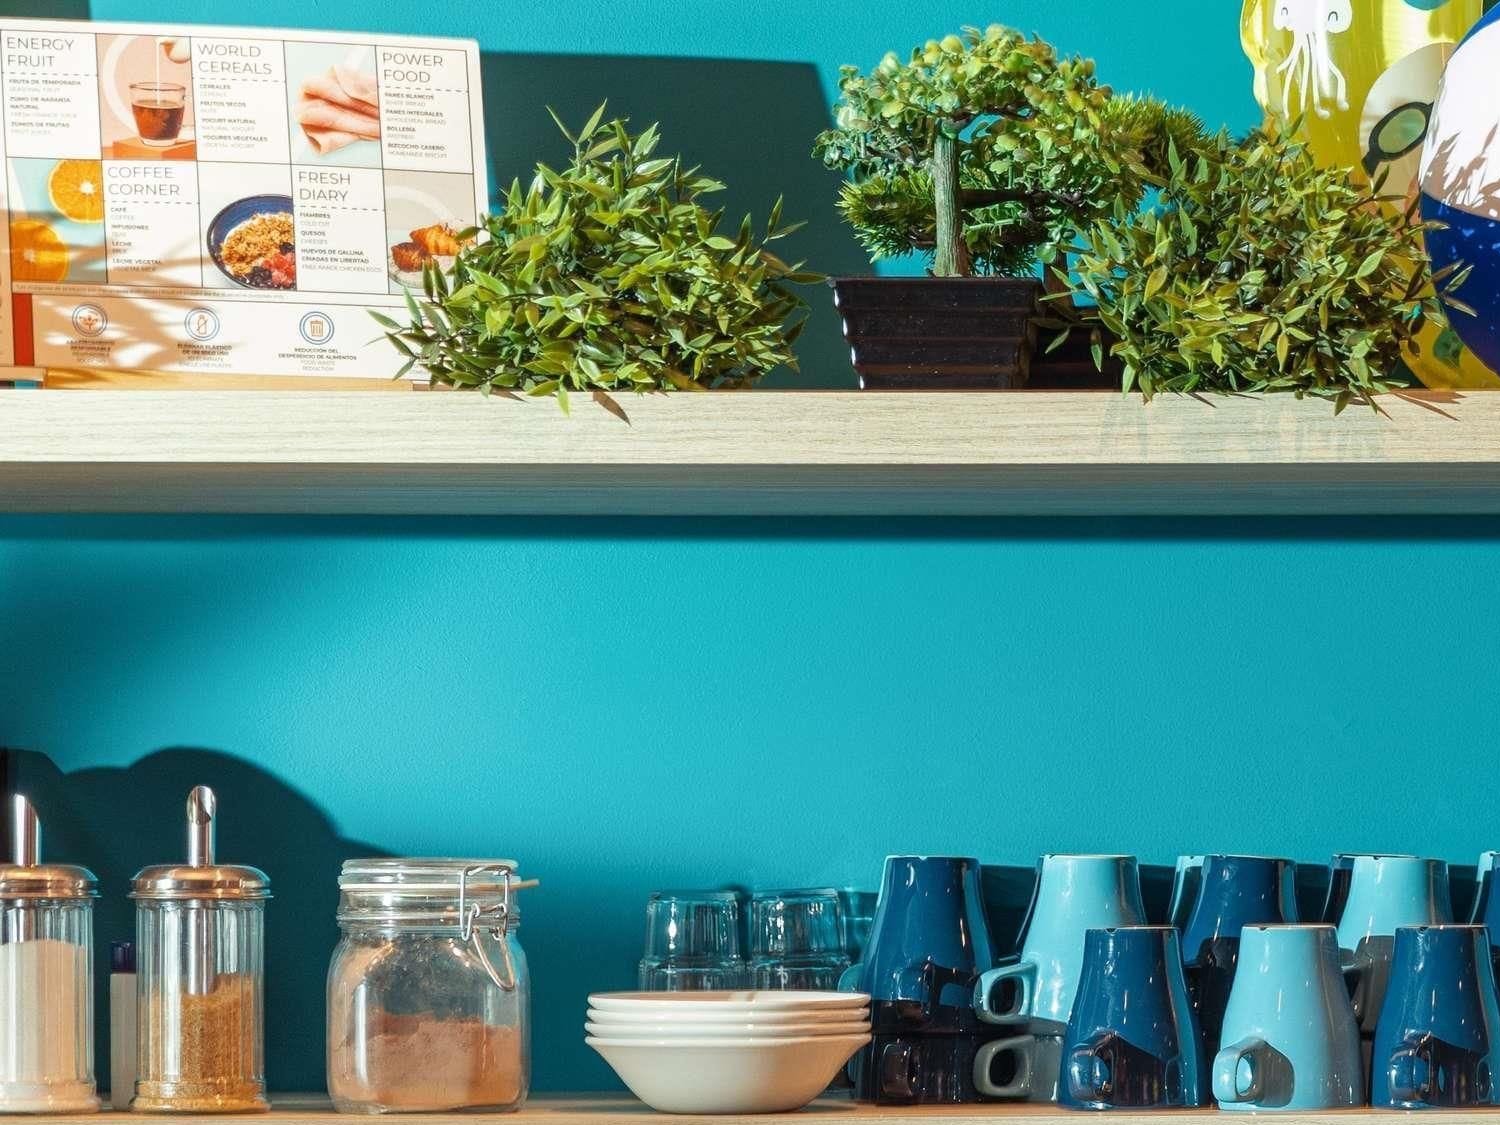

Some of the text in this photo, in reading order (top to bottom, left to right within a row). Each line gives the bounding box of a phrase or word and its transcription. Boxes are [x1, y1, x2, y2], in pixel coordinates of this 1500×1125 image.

[7, 36, 75, 51] ENERGY
[198, 44, 261, 57] WORLD
[7, 54, 56, 68] FRUIT
[383, 52, 443, 67] POWER
[198, 61, 272, 74] CEREALS
[384, 69, 431, 83] FOOD
[108, 166, 176, 178] COFFEE
[298, 171, 351, 185] FRESH
[108, 183, 180, 196] CORNER
[299, 188, 349, 201] DIARY
